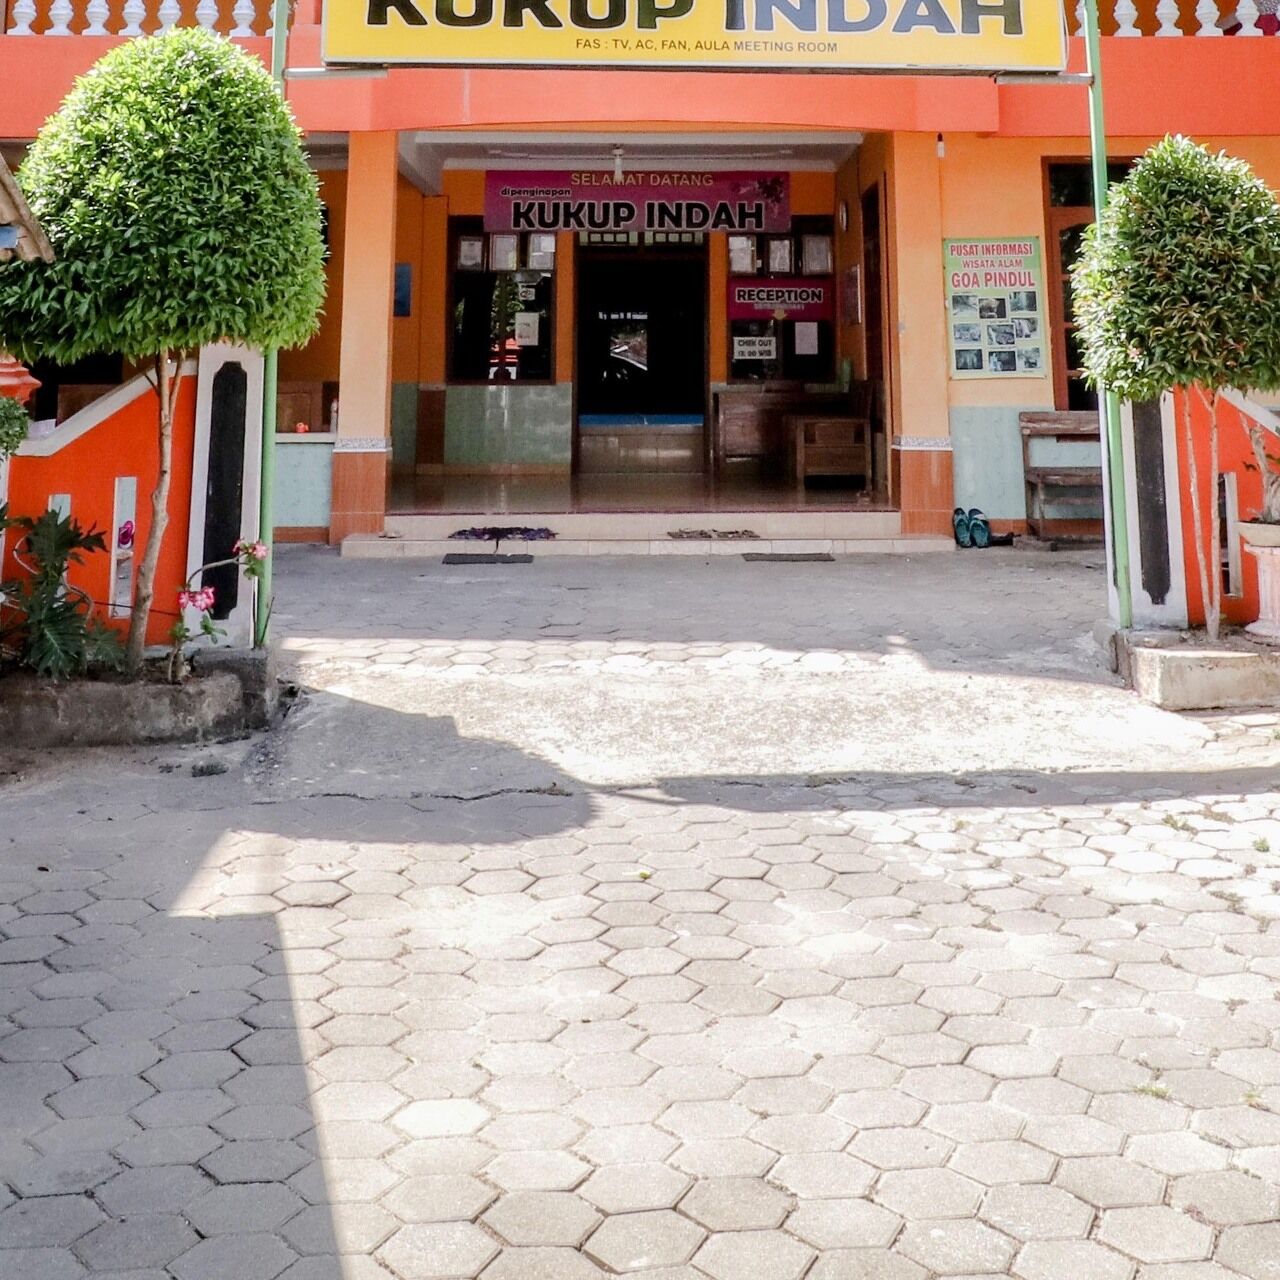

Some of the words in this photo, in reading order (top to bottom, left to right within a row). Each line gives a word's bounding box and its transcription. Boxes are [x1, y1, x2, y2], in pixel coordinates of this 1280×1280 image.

[575, 38, 602, 50] FAS
[611, 38, 632, 51] TV,
[635, 38, 658, 51] AC,
[661, 39, 692, 52] FAN,
[694, 39, 730, 51] AULA
[733, 40, 794, 53] MEETING
[797, 41, 838, 53] ROOM
[649, 173, 714, 186] DATANG
[500, 186, 571, 198] dipenginapan
[511, 200, 636, 230] KUKUP
[645, 200, 765, 230] INDAH
[950, 244, 979, 257] PUSAT
[981, 243, 1033, 256] INFORMASI
[962, 259, 995, 269] WISATA
[997, 259, 1023, 268] ALAM
[951, 272, 980, 289] GOA
[984, 271, 1036, 288] PINDUL
[735, 287, 824, 303] RECEPTION
